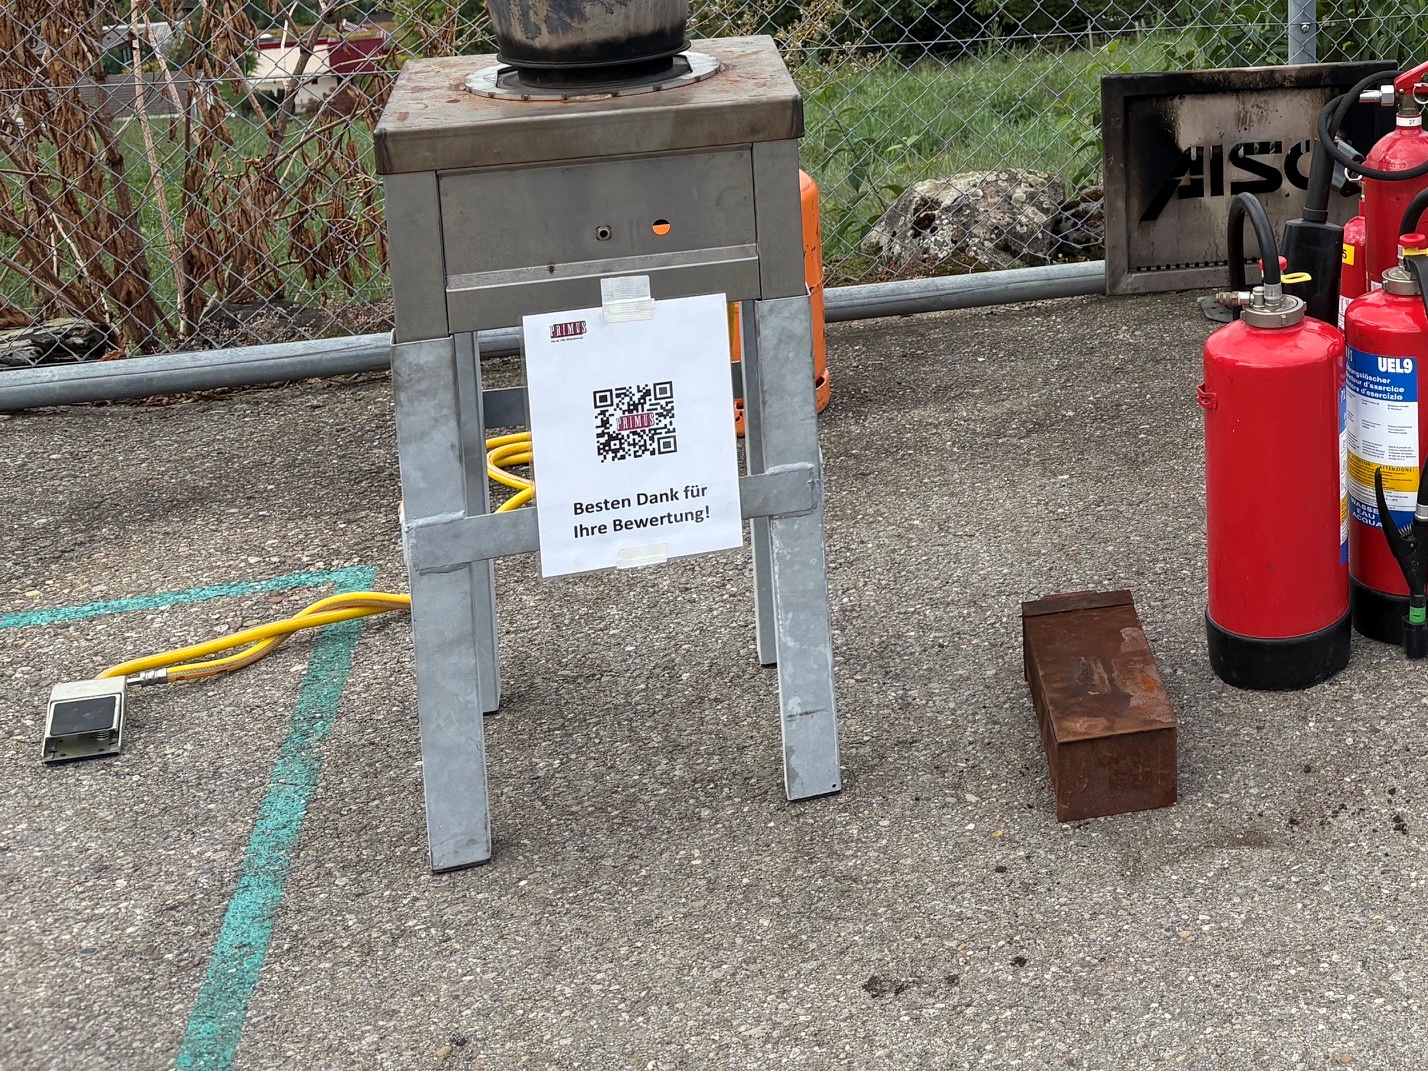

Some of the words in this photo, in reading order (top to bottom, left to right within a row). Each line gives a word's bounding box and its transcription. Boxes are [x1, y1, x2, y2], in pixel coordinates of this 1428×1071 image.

[549, 321, 588, 338] PRIMUS
[1378, 356, 1413, 374] UEL9
[616, 413, 655, 431] PRIMUS
[573, 497, 631, 516] Besten
[636, 488, 679, 506] Dank
[683, 485, 708, 499] für
[1350, 497, 1379, 515] WASSE
[573, 524, 608, 538] Ihre
[612, 505, 710, 532] Bewertung!
[1356, 509, 1376, 519] EAU
